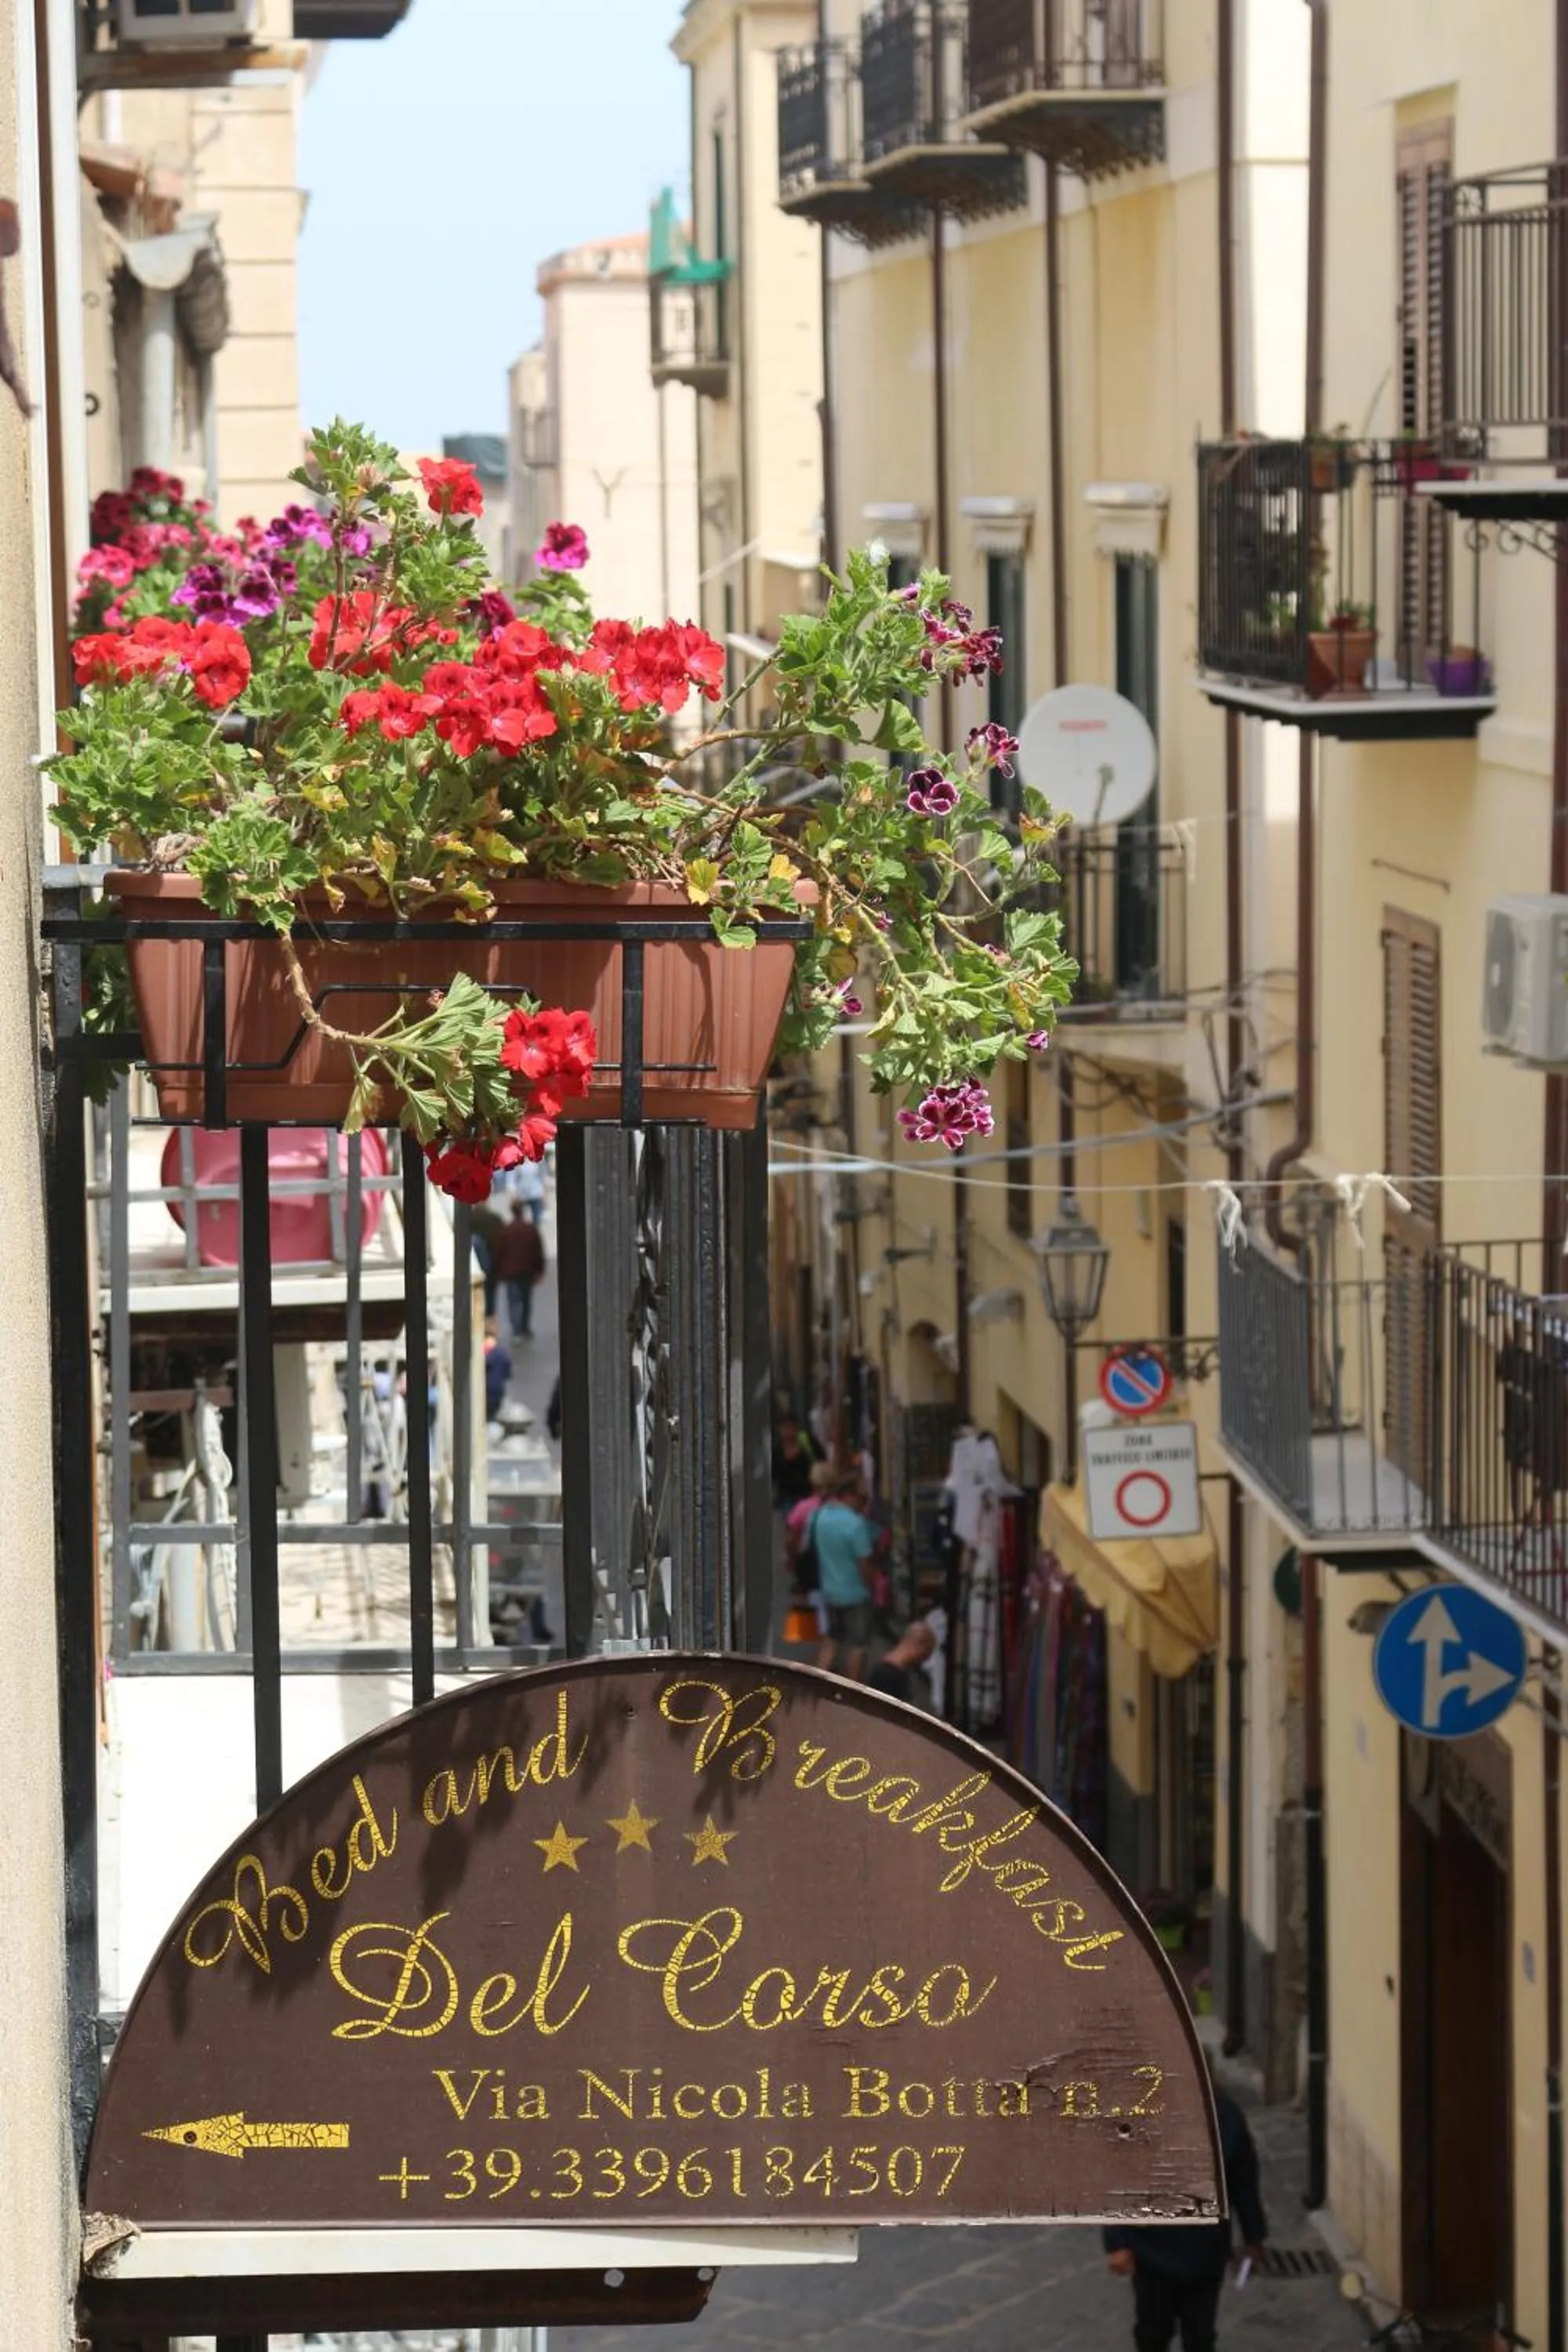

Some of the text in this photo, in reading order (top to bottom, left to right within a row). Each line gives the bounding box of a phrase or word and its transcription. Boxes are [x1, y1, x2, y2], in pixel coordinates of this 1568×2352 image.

[183, 1679, 1124, 1973] Bed and Breakfast
[328, 1906, 998, 2038] Del Corso
[432, 2064, 1164, 2122] Via Nicola Botta n.2
[377, 2143, 967, 2201] +39.3396184507
